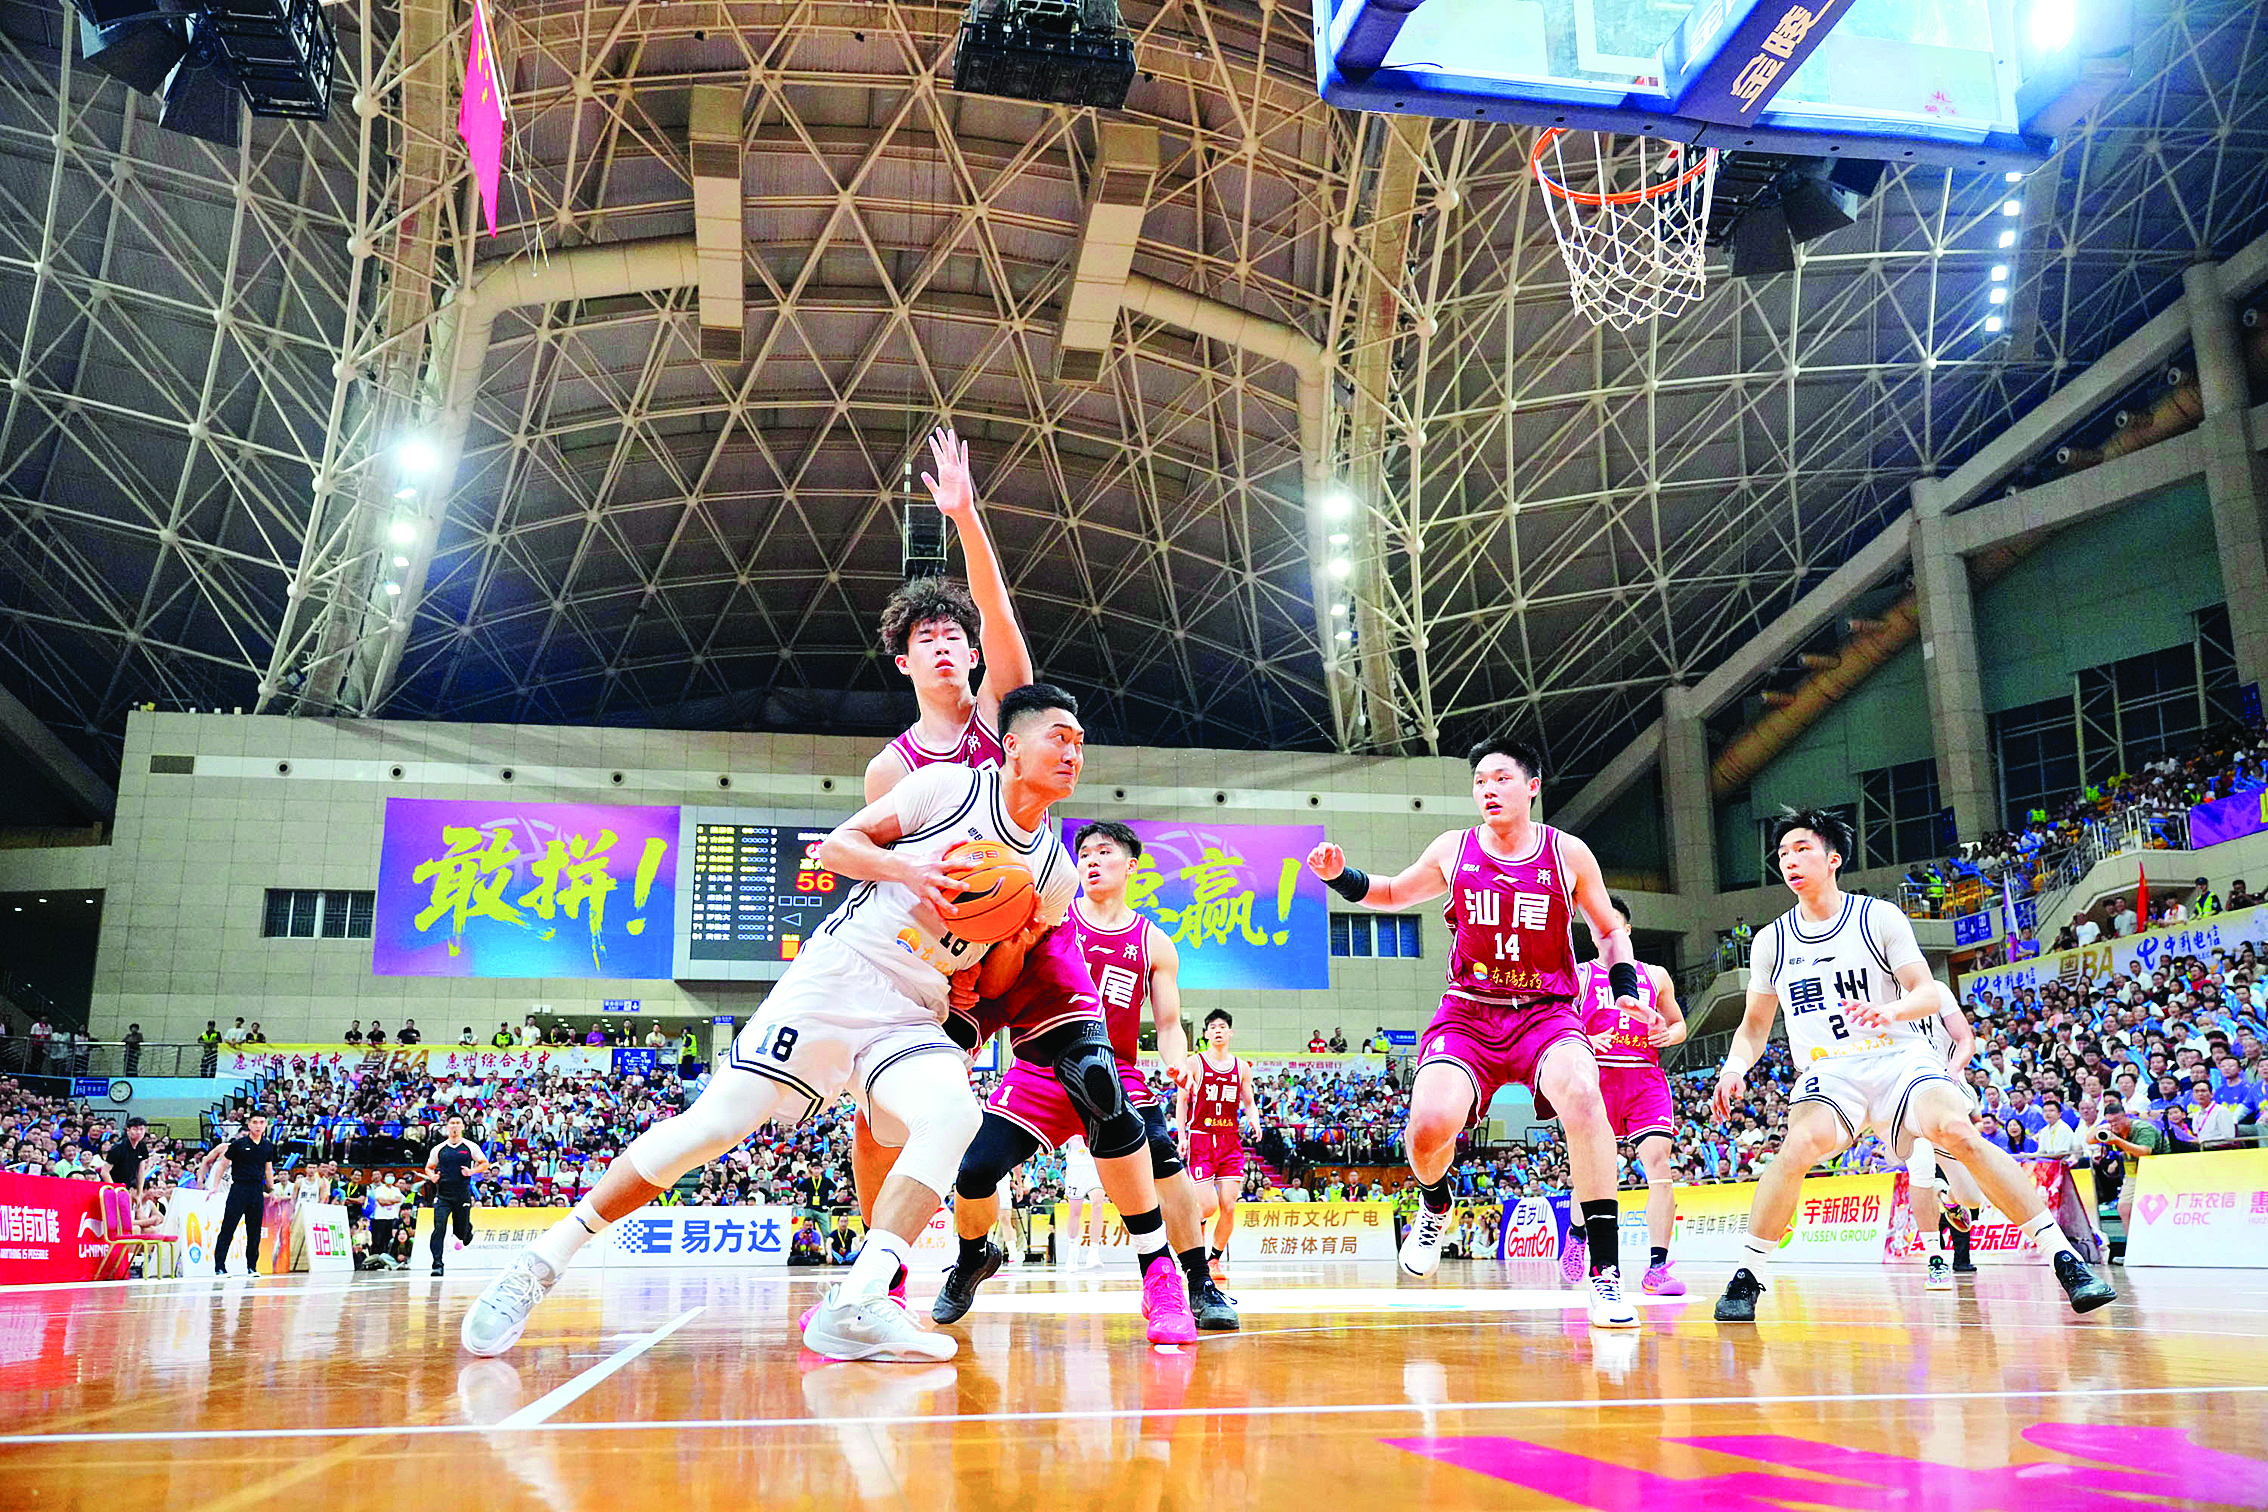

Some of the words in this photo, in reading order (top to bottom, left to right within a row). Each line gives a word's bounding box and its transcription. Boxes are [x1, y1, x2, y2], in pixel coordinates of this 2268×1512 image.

[1730, 0, 1836, 114] 金陵
[796, 871, 836, 893] 56
[412, 826, 667, 970] 敢拼!
[1463, 888, 1550, 931] 汕尾
[1495, 932, 1520, 962] 14
[2164, 924, 2221, 957] 中国电信
[2057, 945, 2114, 988] 粤BA
[1788, 967, 1871, 1017] 惠州
[1618, 1010, 1631, 1030] 2
[1828, 1014, 1850, 1040] 2
[755, 1024, 799, 1062] 18
[445, 1050, 551, 1070] 惠州综合高中
[997, 1085, 1014, 1107] 1
[1805, 1076, 1821, 1094] 2
[1215, 1102, 1222, 1116] 0
[1195, 1166, 1203, 1179] 0
[1803, 1195, 1880, 1224] 宇新股份
[2175, 1192, 2236, 1209] 广东农信
[1243, 1209, 1379, 1227] 惠州市文化广电
[1516, 1203, 1548, 1226] 百岁山
[2172, 1212, 2212, 1225] GDRC
[681, 1218, 781, 1254] 易方达
[1260, 1236, 1357, 1255] 旅游体育局
[1801, 1231, 1837, 1243] YUSSEN
[1840, 1229, 1877, 1242] GROUP
